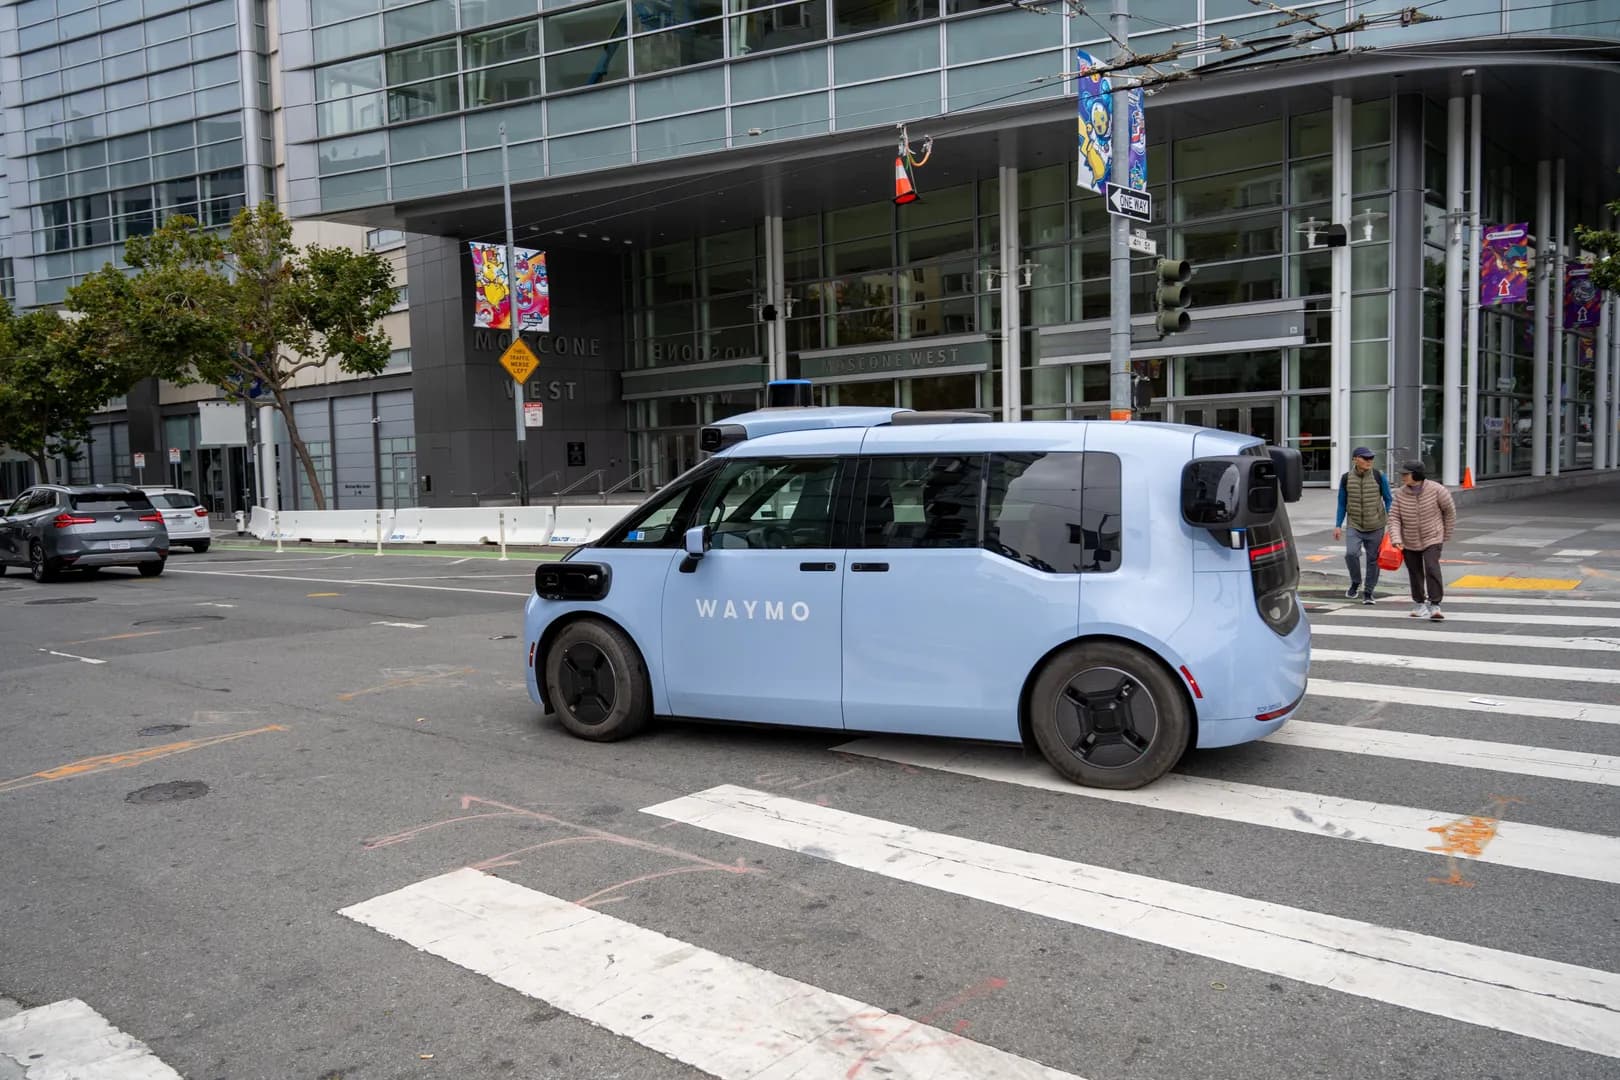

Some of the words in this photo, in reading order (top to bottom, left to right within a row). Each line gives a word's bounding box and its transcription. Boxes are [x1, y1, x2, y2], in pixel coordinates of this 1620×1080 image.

[1120, 195, 1133, 208] ONE
[1134, 199, 1147, 213] WAY
[910, 348, 959, 366] WEST
[695, 598, 810, 622] WAYMO
